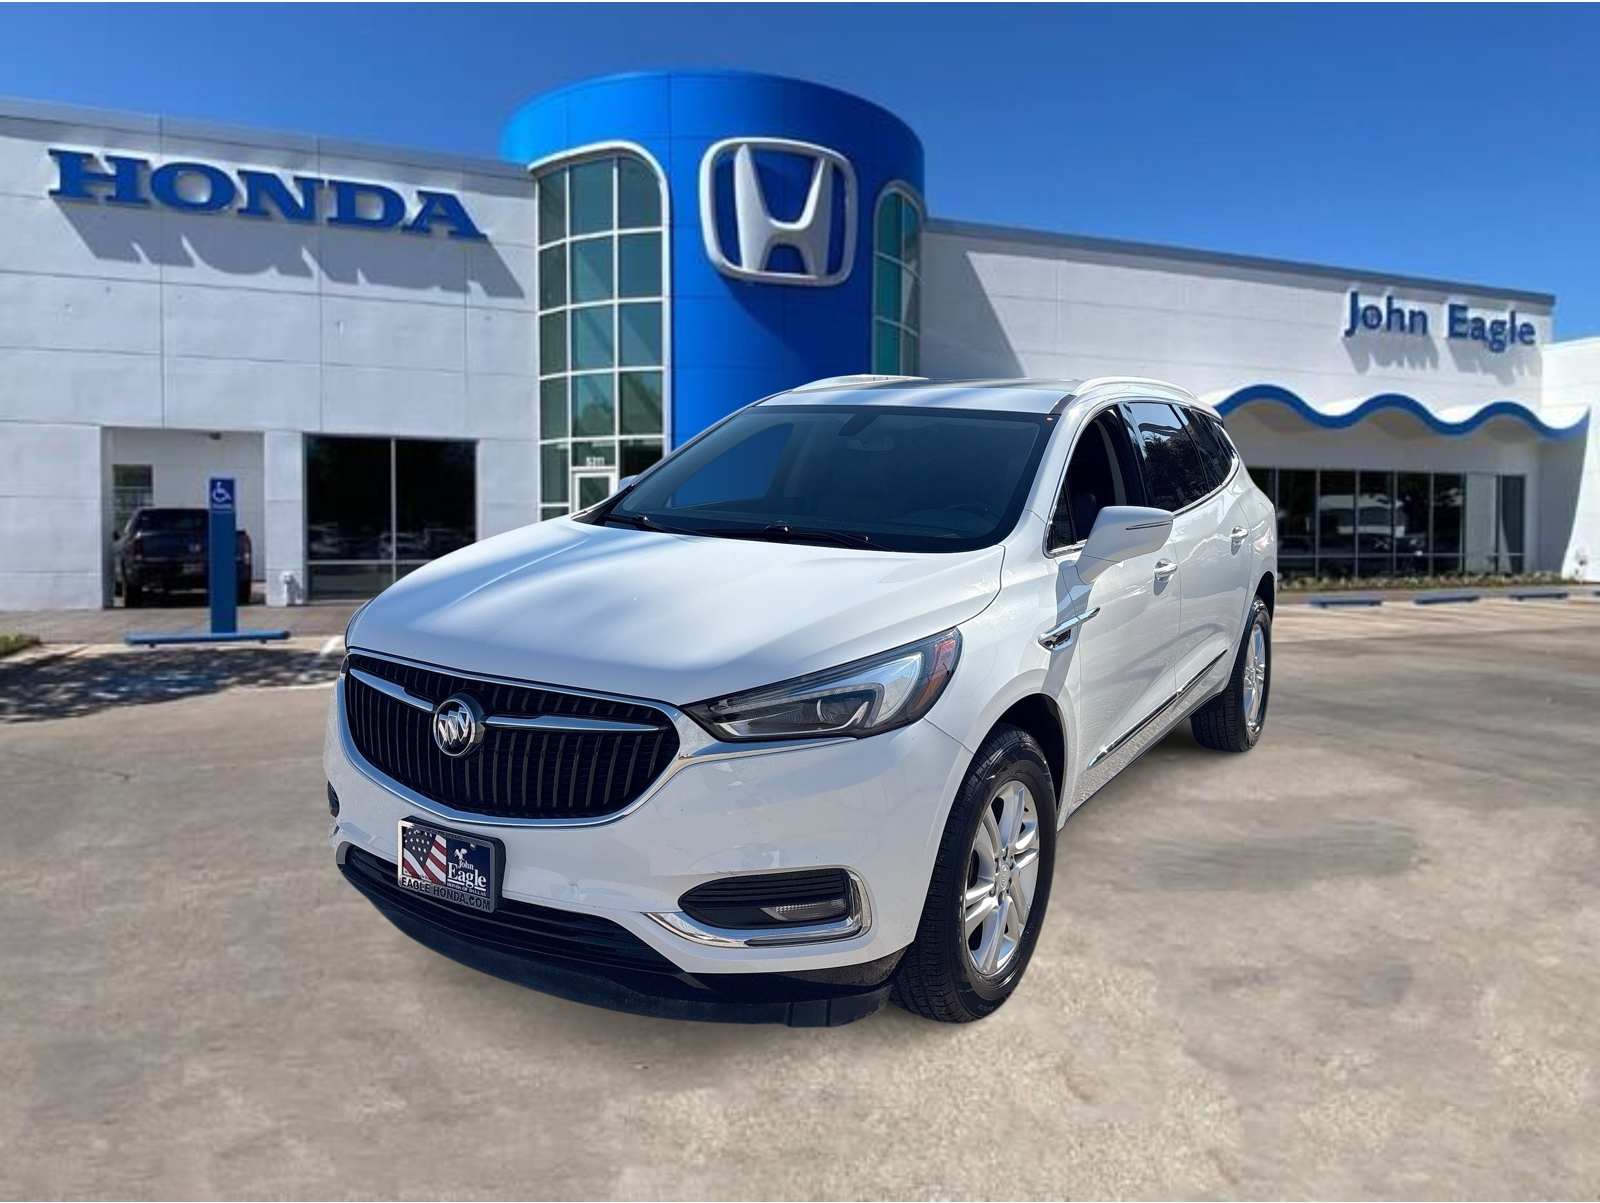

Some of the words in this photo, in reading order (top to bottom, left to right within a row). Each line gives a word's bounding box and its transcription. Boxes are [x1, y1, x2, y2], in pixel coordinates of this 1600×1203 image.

[48, 148, 488, 241] HONDA
[1344, 290, 1428, 338] John
[1448, 303, 1536, 353] Eagle
[447, 862, 486, 889] Eagle
[458, 860, 474, 870] John
[401, 876, 431, 893] EAGLE
